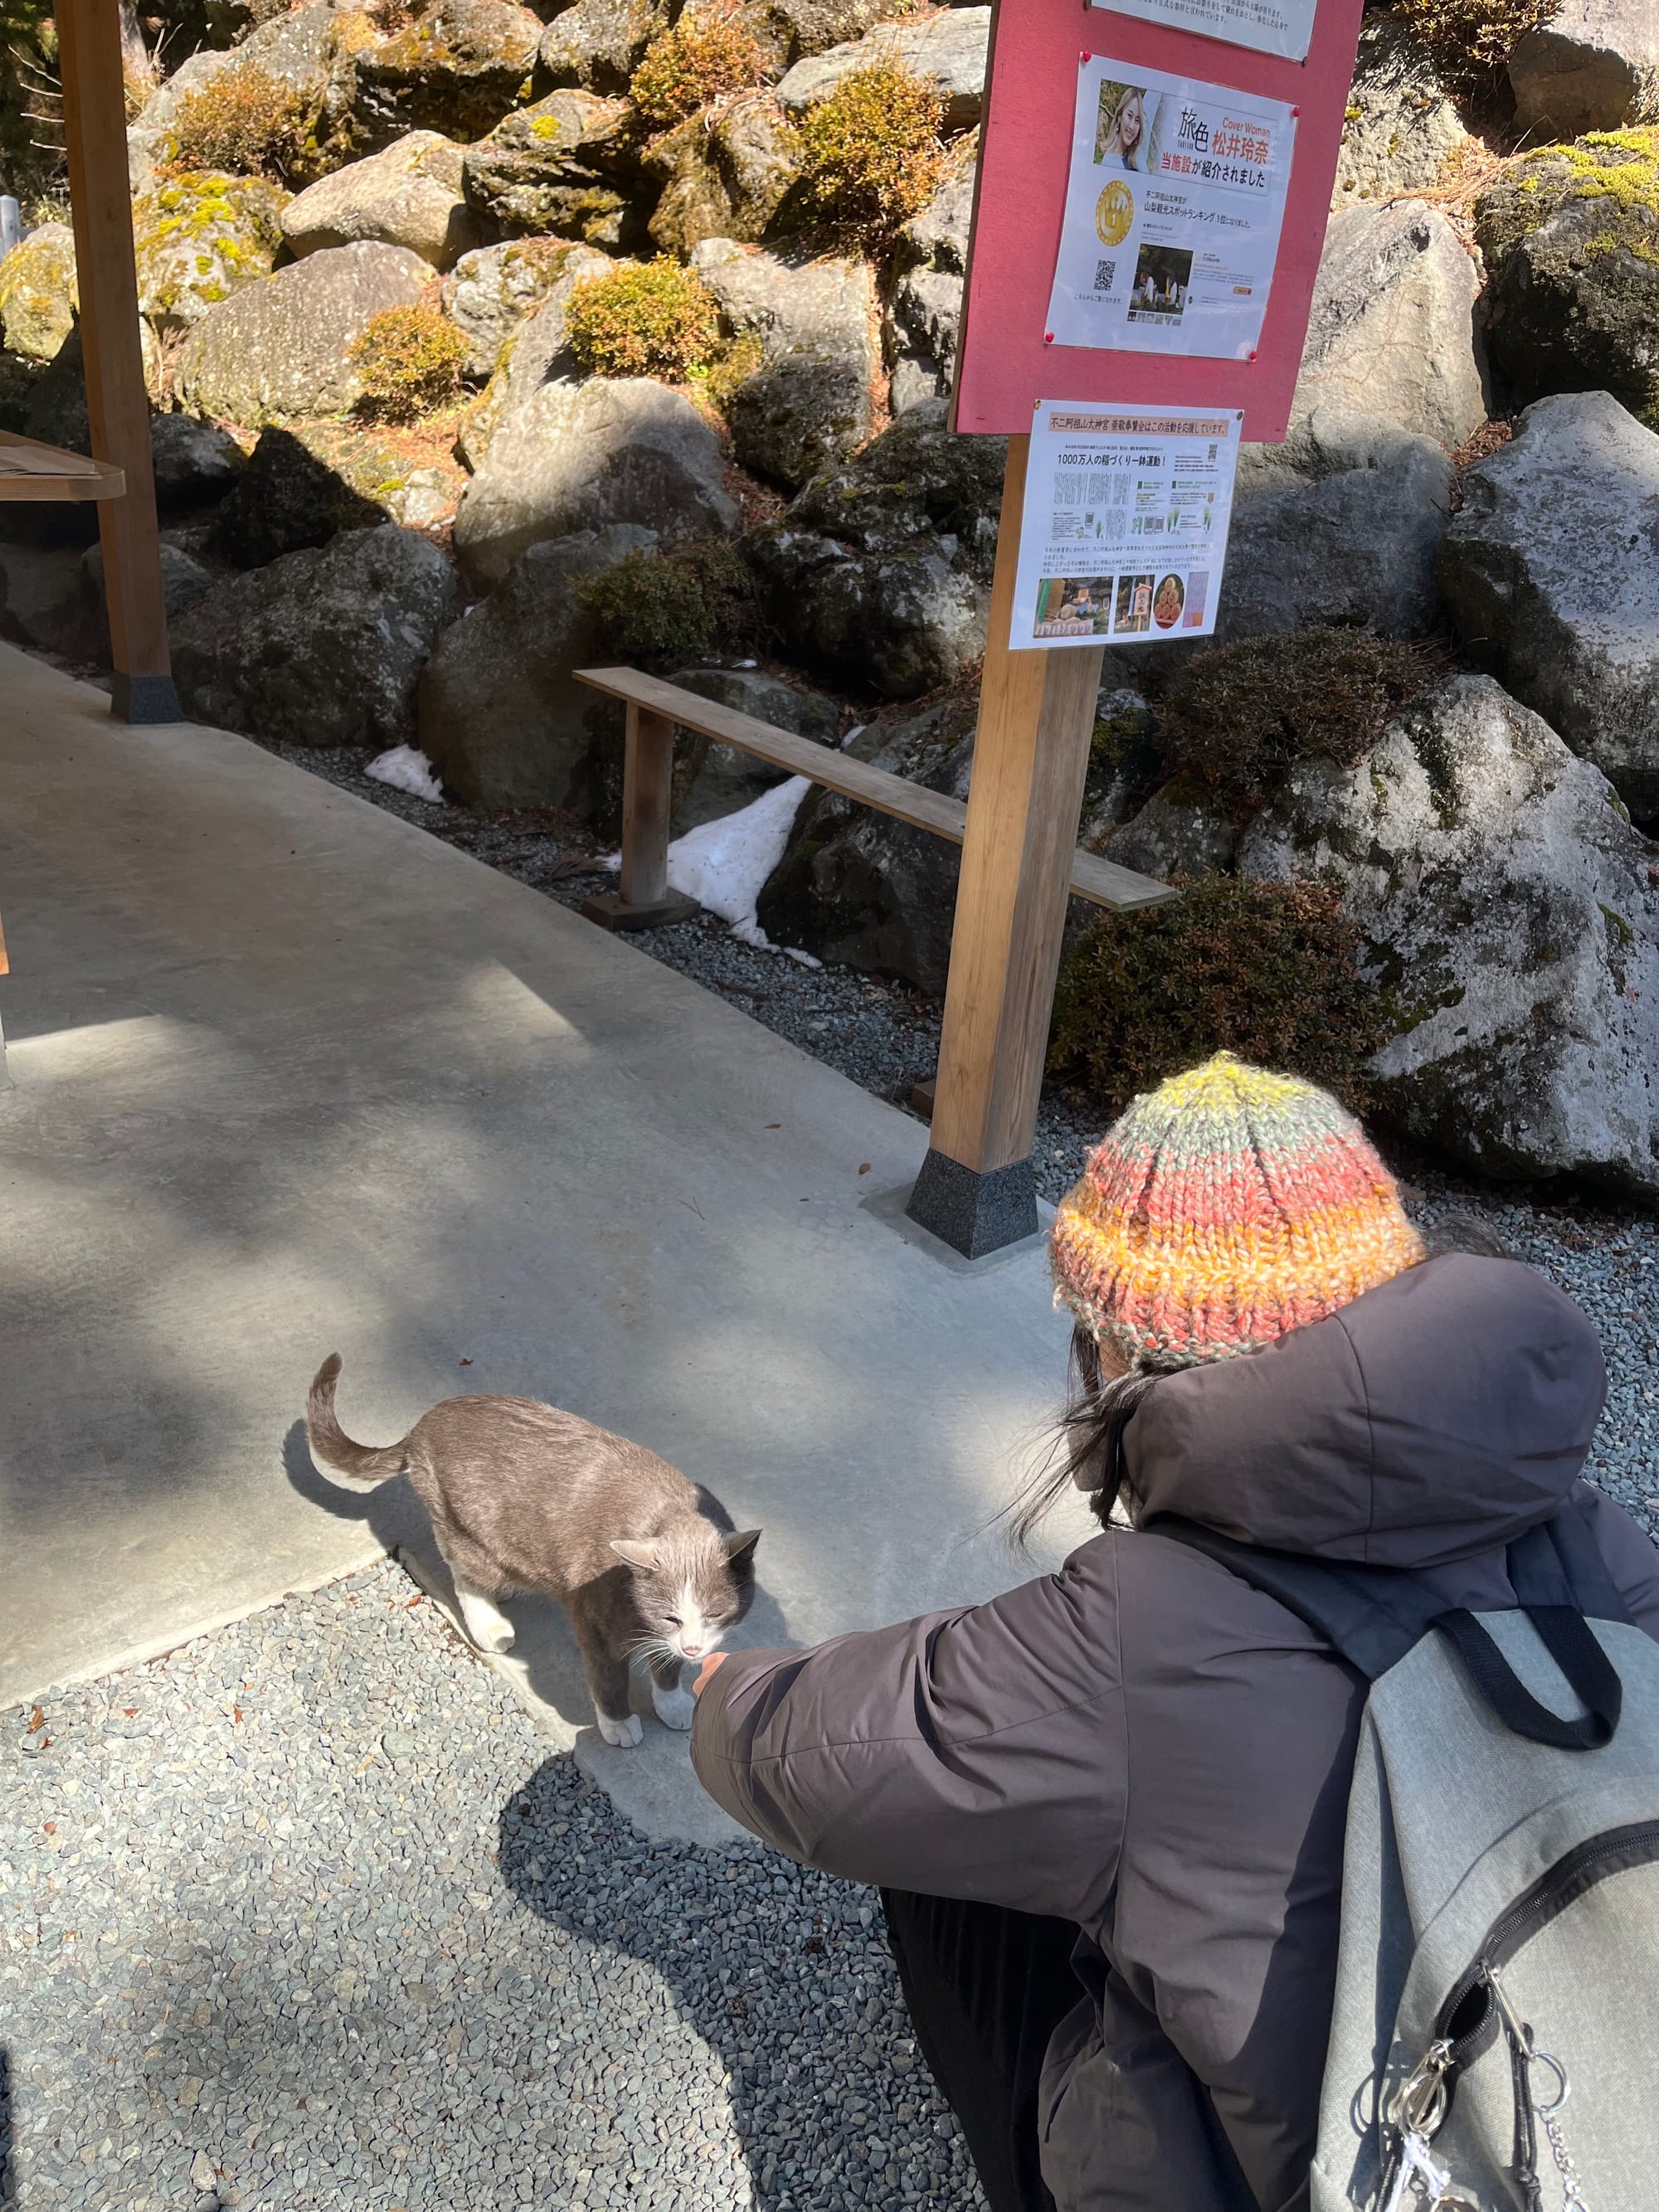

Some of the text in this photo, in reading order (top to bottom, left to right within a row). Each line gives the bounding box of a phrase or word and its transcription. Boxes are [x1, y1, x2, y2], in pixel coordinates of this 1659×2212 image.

[1178, 106, 1209, 154] 旅色
[1222, 116, 1271, 139] Cover Woman
[1211, 129, 1269, 166] 松井玲奈
[1160, 152, 1266, 189] 当施設が紹介されました
